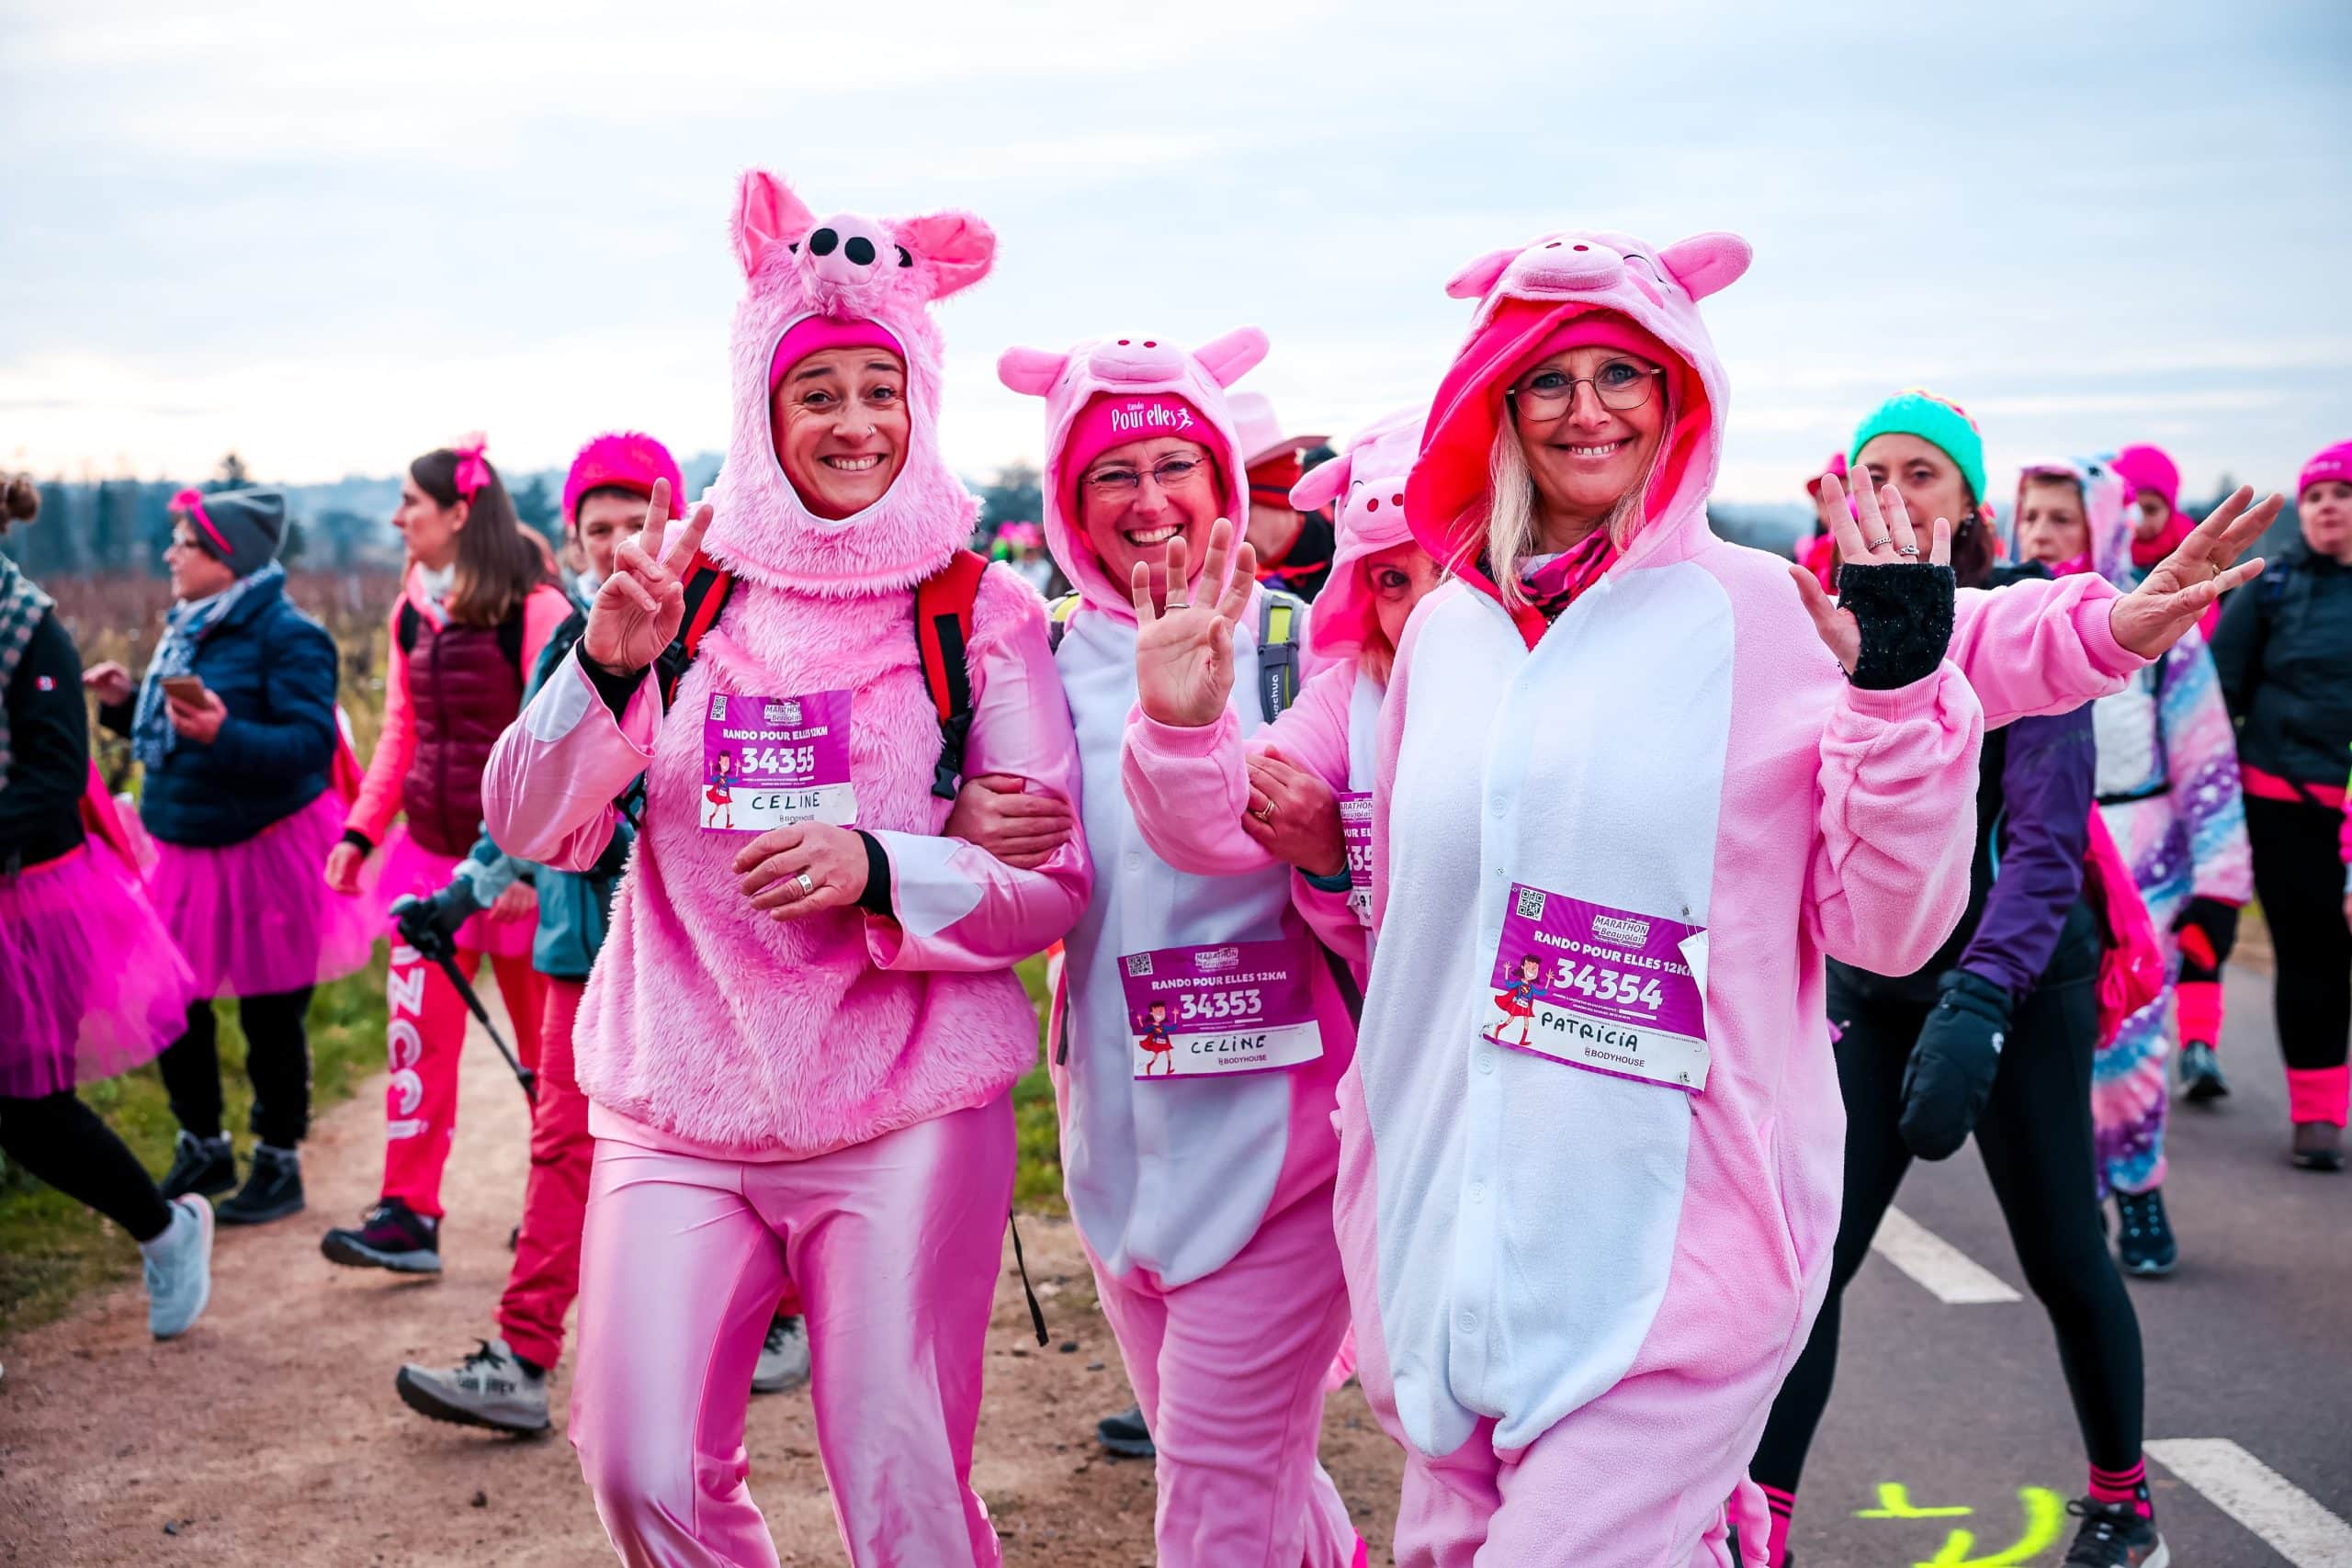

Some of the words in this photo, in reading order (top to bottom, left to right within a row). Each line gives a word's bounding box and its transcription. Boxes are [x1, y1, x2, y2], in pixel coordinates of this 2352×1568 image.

[1112, 409, 1145, 432] Pour
[1147, 404, 1176, 426] elles
[723, 728, 757, 740] RANDO
[760, 730, 790, 741] POUR
[741, 746, 815, 774] 34355
[1344, 829, 1359, 838] UR
[1595, 916, 1648, 933] MARATHON
[1600, 928, 1645, 942] Beaujolais
[1533, 931, 1580, 953] RANDO
[1582, 941, 1621, 963] POUR
[1623, 953, 1661, 971] ELLES
[1151, 979, 1192, 991] RANDO
[1193, 976, 1223, 987] POUR
[1225, 973, 1255, 984] ELLES
[1258, 971, 1287, 982] 12KM
[1553, 958, 1664, 1010] 34354
[1180, 989, 1262, 1020] 34353
[1223, 1055, 1267, 1066] BODYHOUSE
[1591, 1049, 1645, 1067] BODYHOUSE
